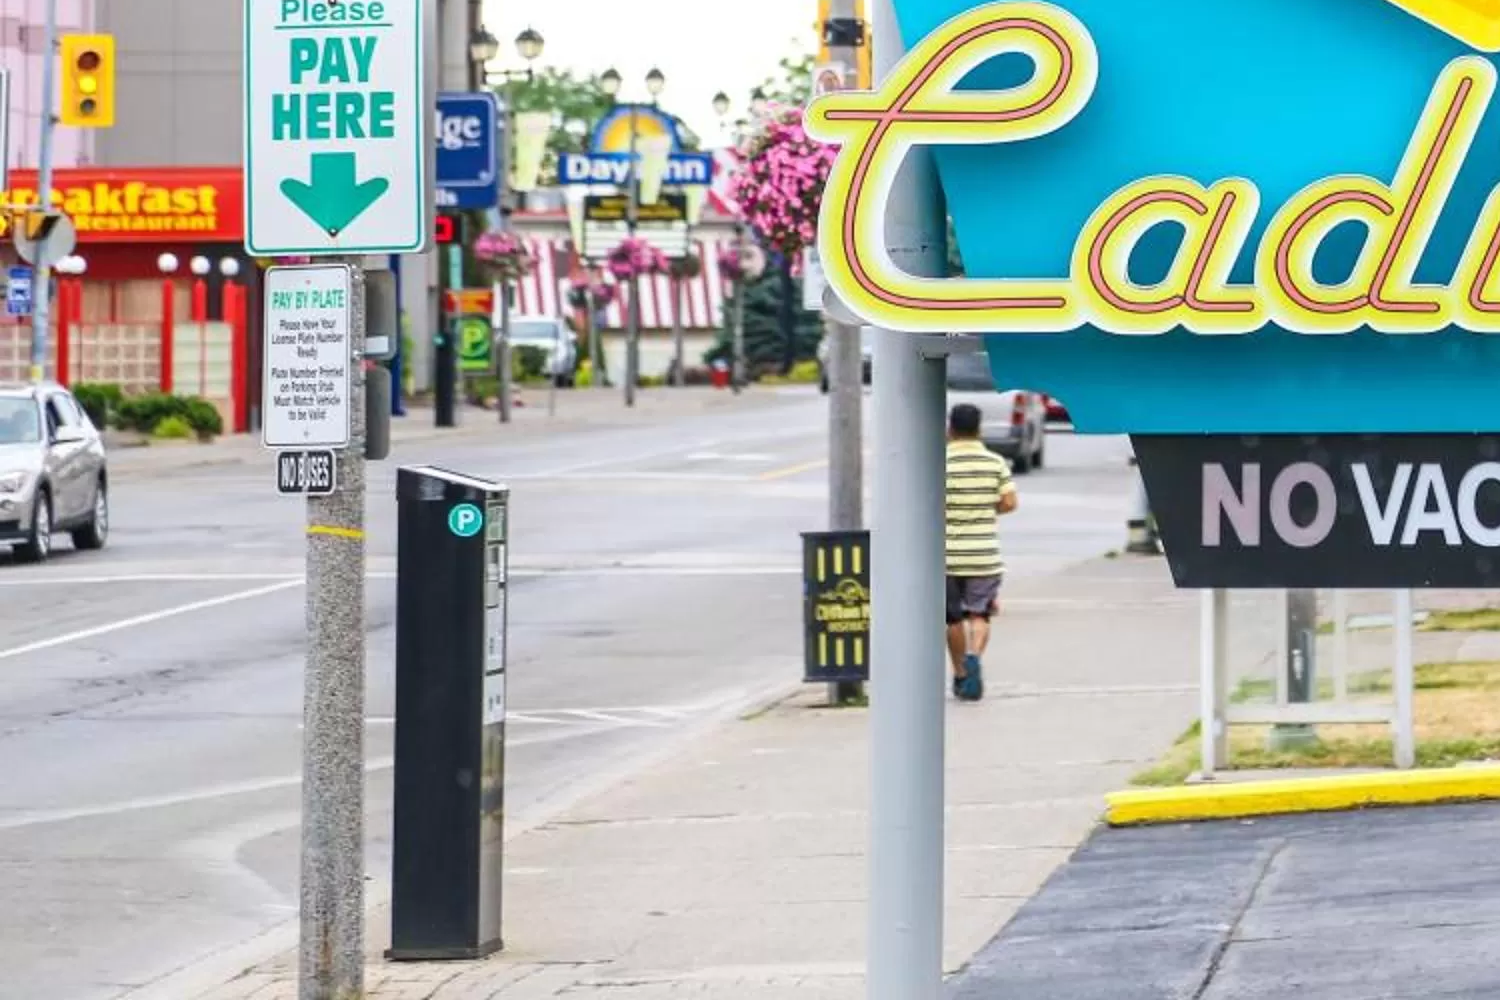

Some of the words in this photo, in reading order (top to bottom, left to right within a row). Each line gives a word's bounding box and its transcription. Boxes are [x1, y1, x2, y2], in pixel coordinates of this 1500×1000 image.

[289, 35, 378, 84] PAY
[272, 91, 395, 140] HERE
[271, 291, 293, 310] PAY
[295, 291, 308, 309] BY
[311, 289, 345, 309] PLATE
[281, 457, 297, 488] NO
[297, 456, 330, 487] BUSES
[1201, 461, 1338, 548] NO
